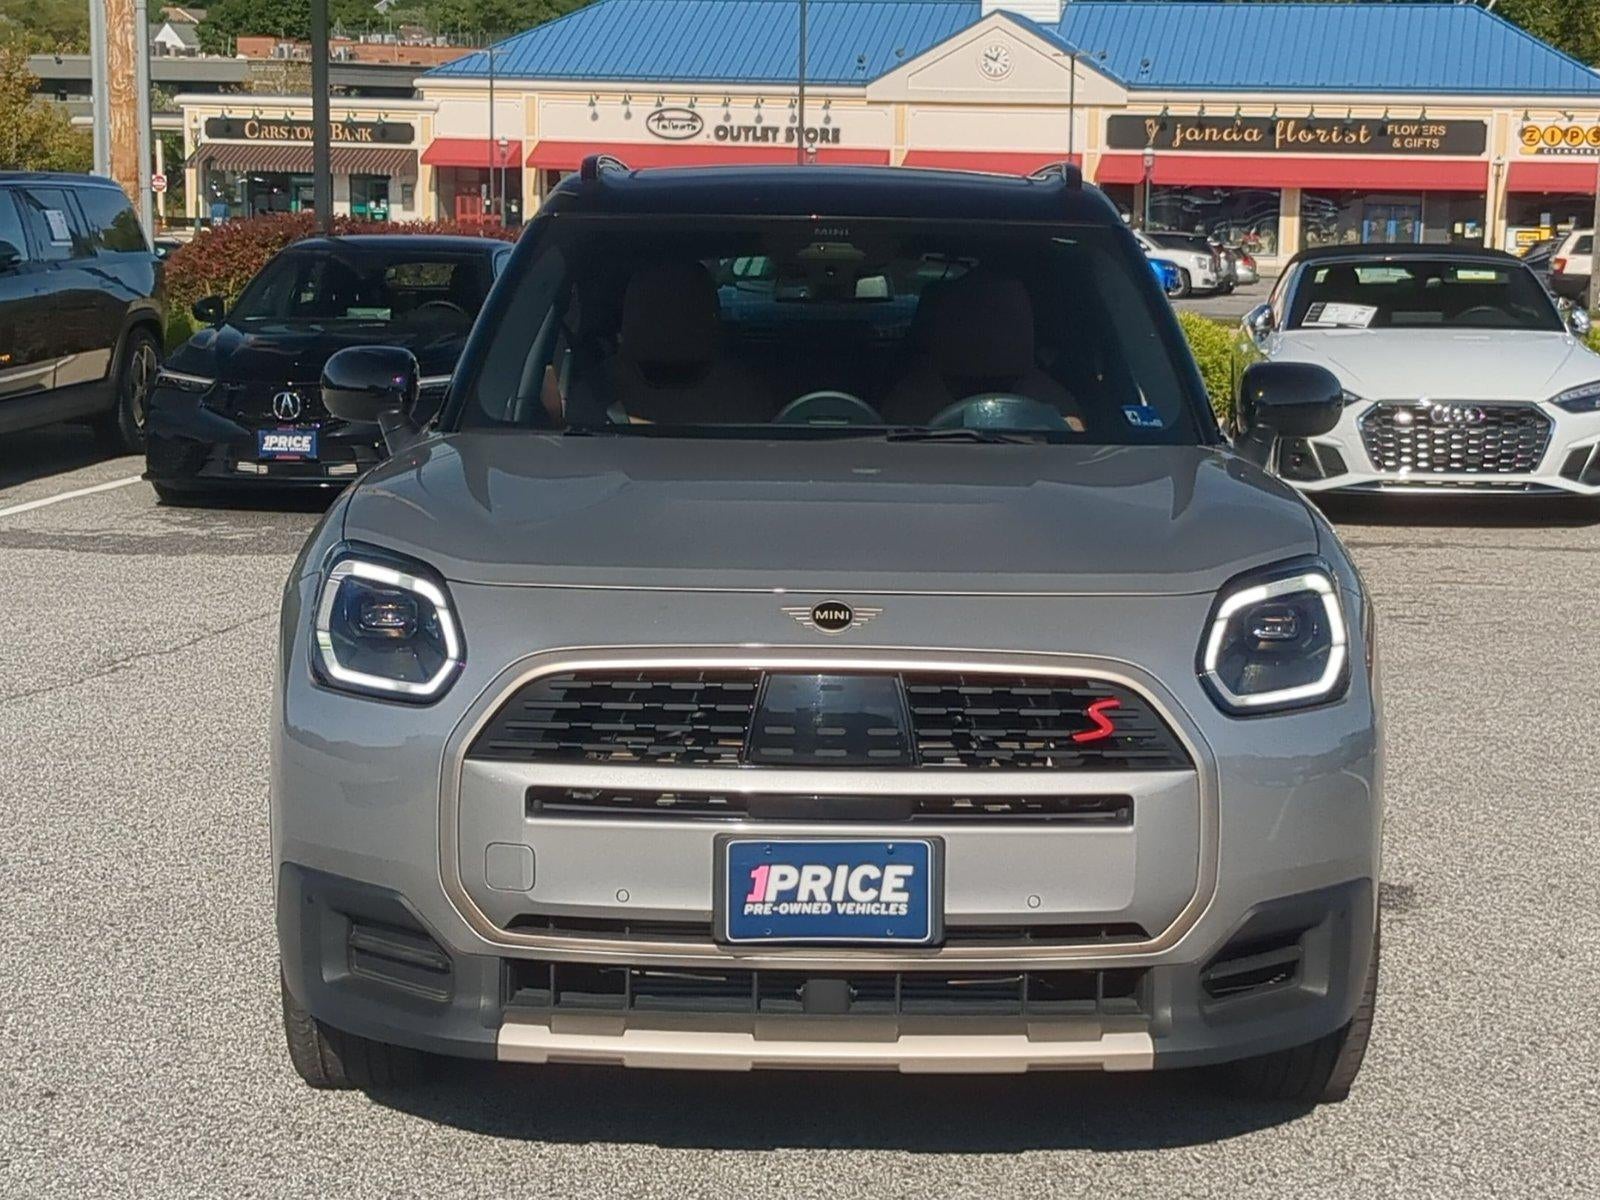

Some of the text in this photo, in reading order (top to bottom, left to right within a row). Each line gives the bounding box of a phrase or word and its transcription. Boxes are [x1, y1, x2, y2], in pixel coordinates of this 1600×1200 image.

[331, 123, 372, 142] BANK
[714, 125, 780, 143] OUTLET
[1172, 119, 1372, 149] janda florist
[1525, 129, 1600, 144] ZIPS
[1392, 137, 1440, 149] & GIFTS
[814, 227, 849, 236] MINI
[815, 610, 850, 620] MINI
[746, 864, 914, 903] 1PRICE
[743, 901, 908, 916] PRE-OWNED VEHICLES
